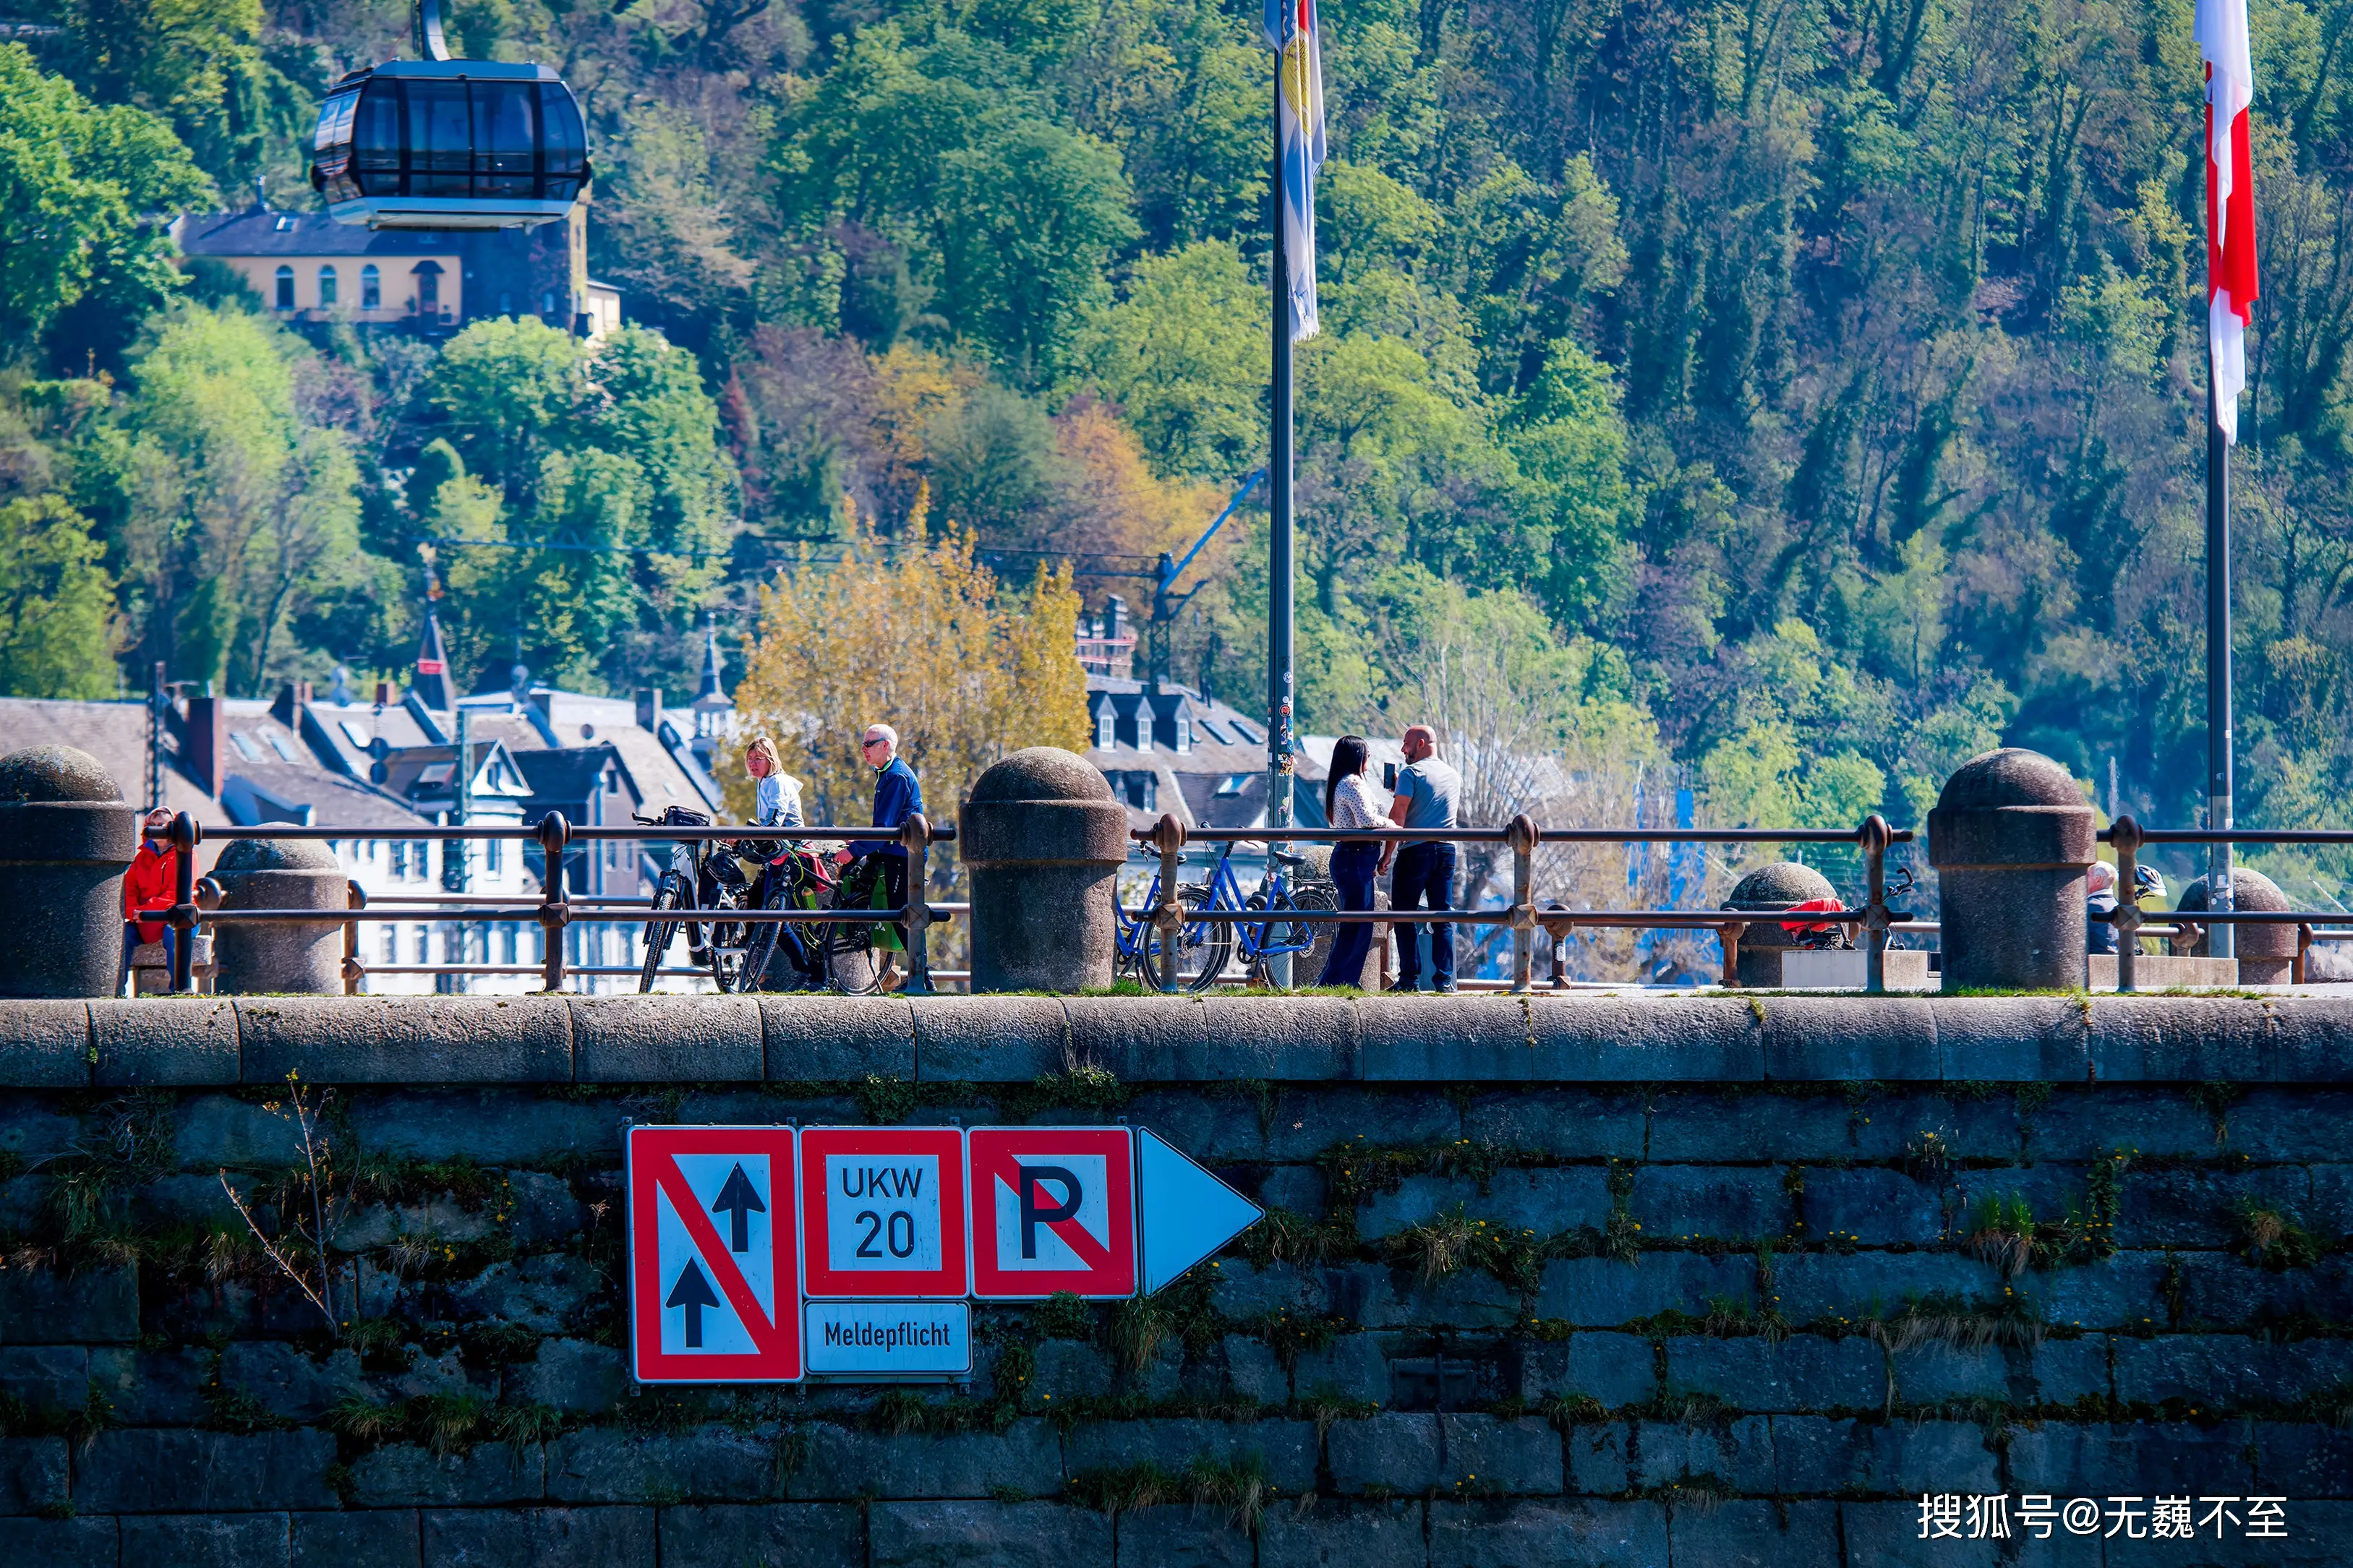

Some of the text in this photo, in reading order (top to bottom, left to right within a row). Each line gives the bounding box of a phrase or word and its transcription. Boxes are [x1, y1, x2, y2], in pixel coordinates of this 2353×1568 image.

[842, 1168, 923, 1198] UKW
[1020, 1165, 1083, 1259] P
[855, 1210, 915, 1259] 20
[824, 1321, 950, 1353] Meldepflicht
